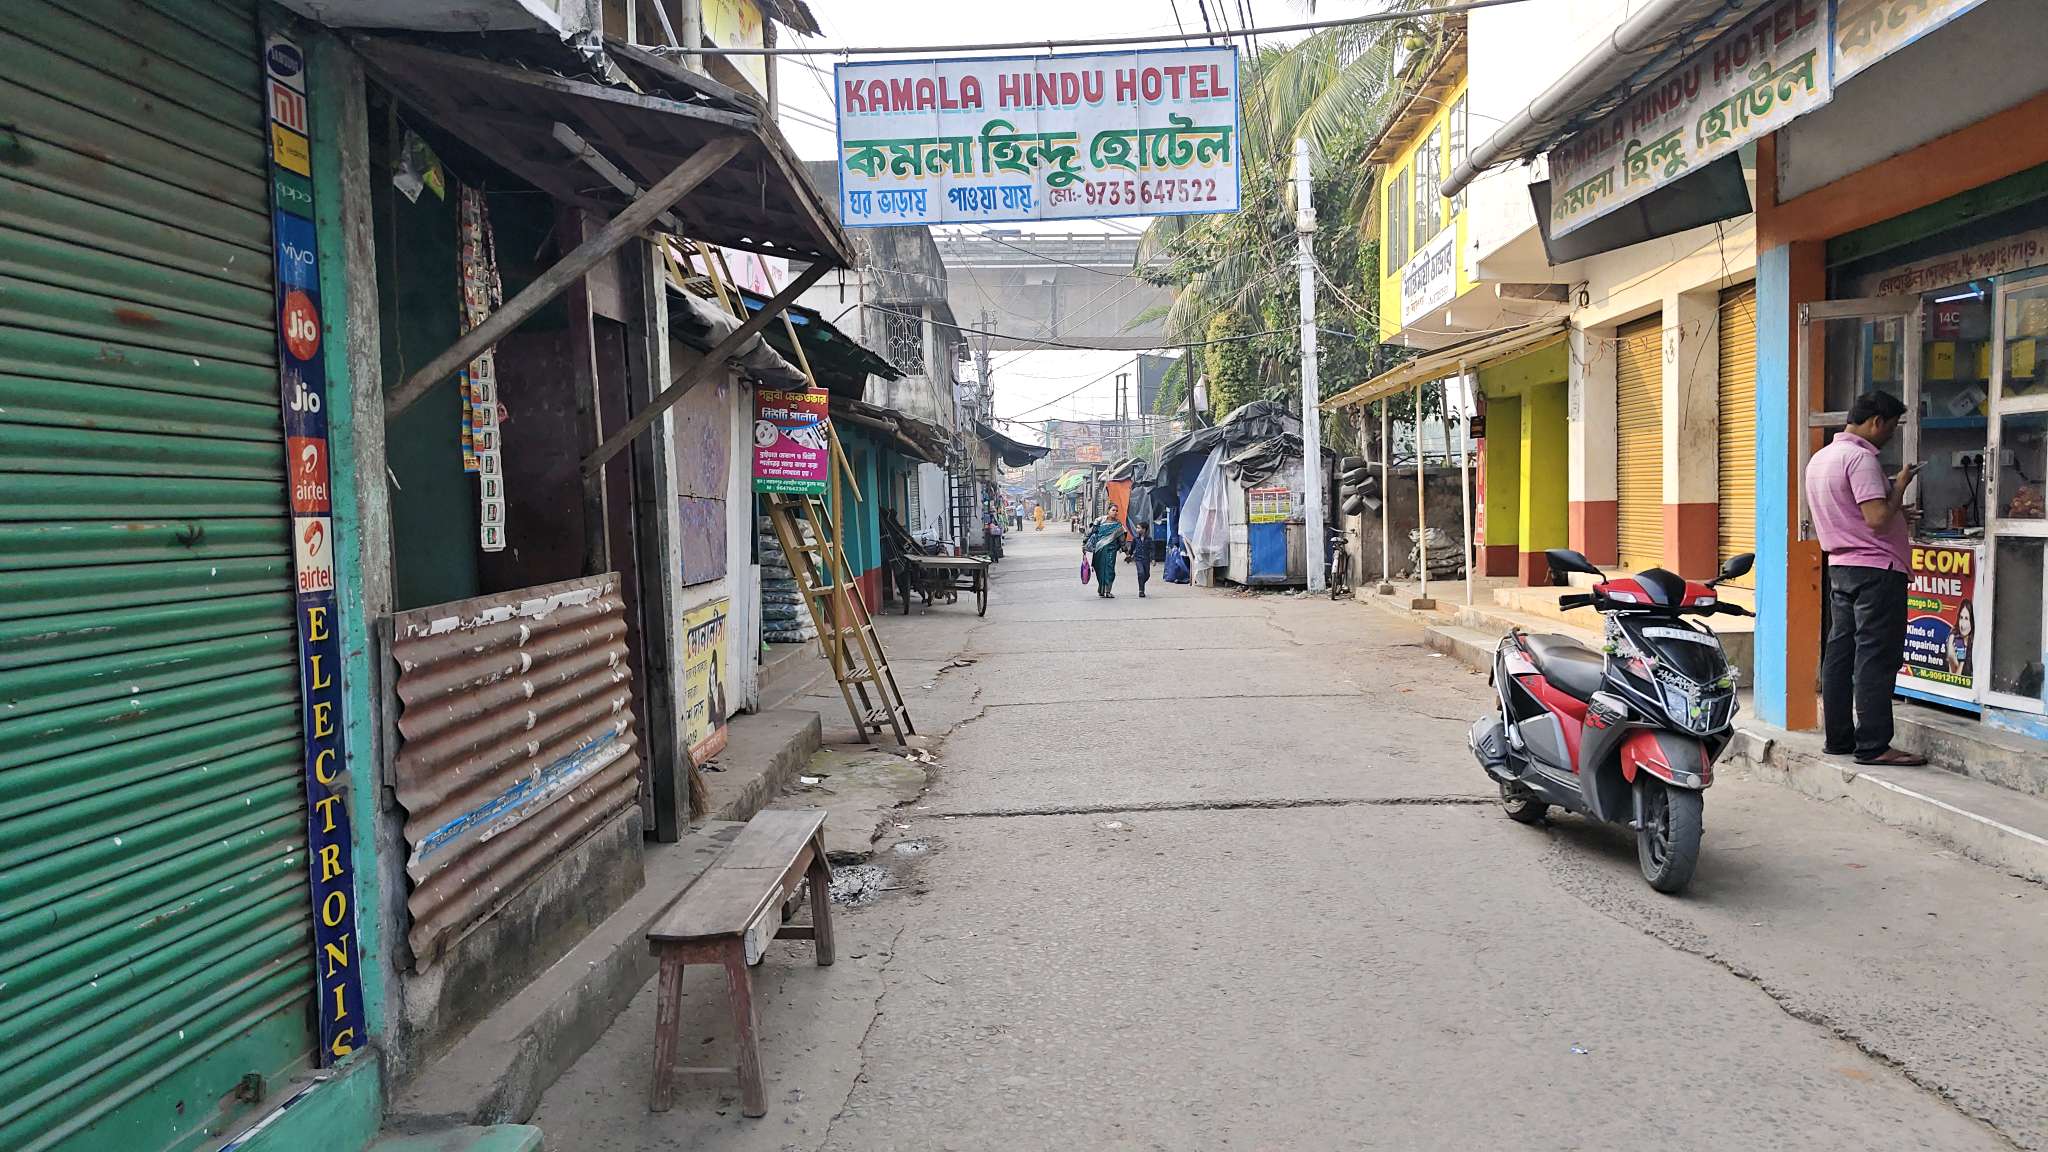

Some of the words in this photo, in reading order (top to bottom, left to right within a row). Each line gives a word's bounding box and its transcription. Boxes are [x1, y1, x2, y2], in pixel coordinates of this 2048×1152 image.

[845, 74, 982, 112] KAMALA
[998, 69, 1102, 107] HINDU
[1116, 64, 1230, 102] HOTEL
[1552, 120, 1624, 184] KAMALA
[1632, 70, 1701, 132] HINDU
[1712, 2, 1820, 83] HOTEL
[1551, 166, 1615, 221] কমলা
[1621, 121, 1689, 179] হিন্দু
[1695, 49, 1818, 143] হোটেল
[843, 136, 973, 178] কমলা
[979, 119, 1087, 187] হিন্দু
[1089, 113, 1233, 172] হোটেল
[849, 190, 873, 218] ঘর
[877, 188, 928, 218] ভাড়ায়
[948, 186, 998, 215] পাওয়া
[282, 242, 314, 265] vivo
[287, 308, 317, 342] Jio
[290, 382, 321, 413] Jio
[296, 481, 328, 501] airtel
[1911, 549, 1970, 574] ECOM
[300, 565, 333, 591] airtel
[1908, 576, 1962, 596] NLINE
[1906, 624, 1926, 637] Kinds
[1927, 629, 1935, 638] of
[1909, 639, 1940, 654] repairing
[1911, 651, 1927, 663] done
[1928, 654, 1944, 666] here
